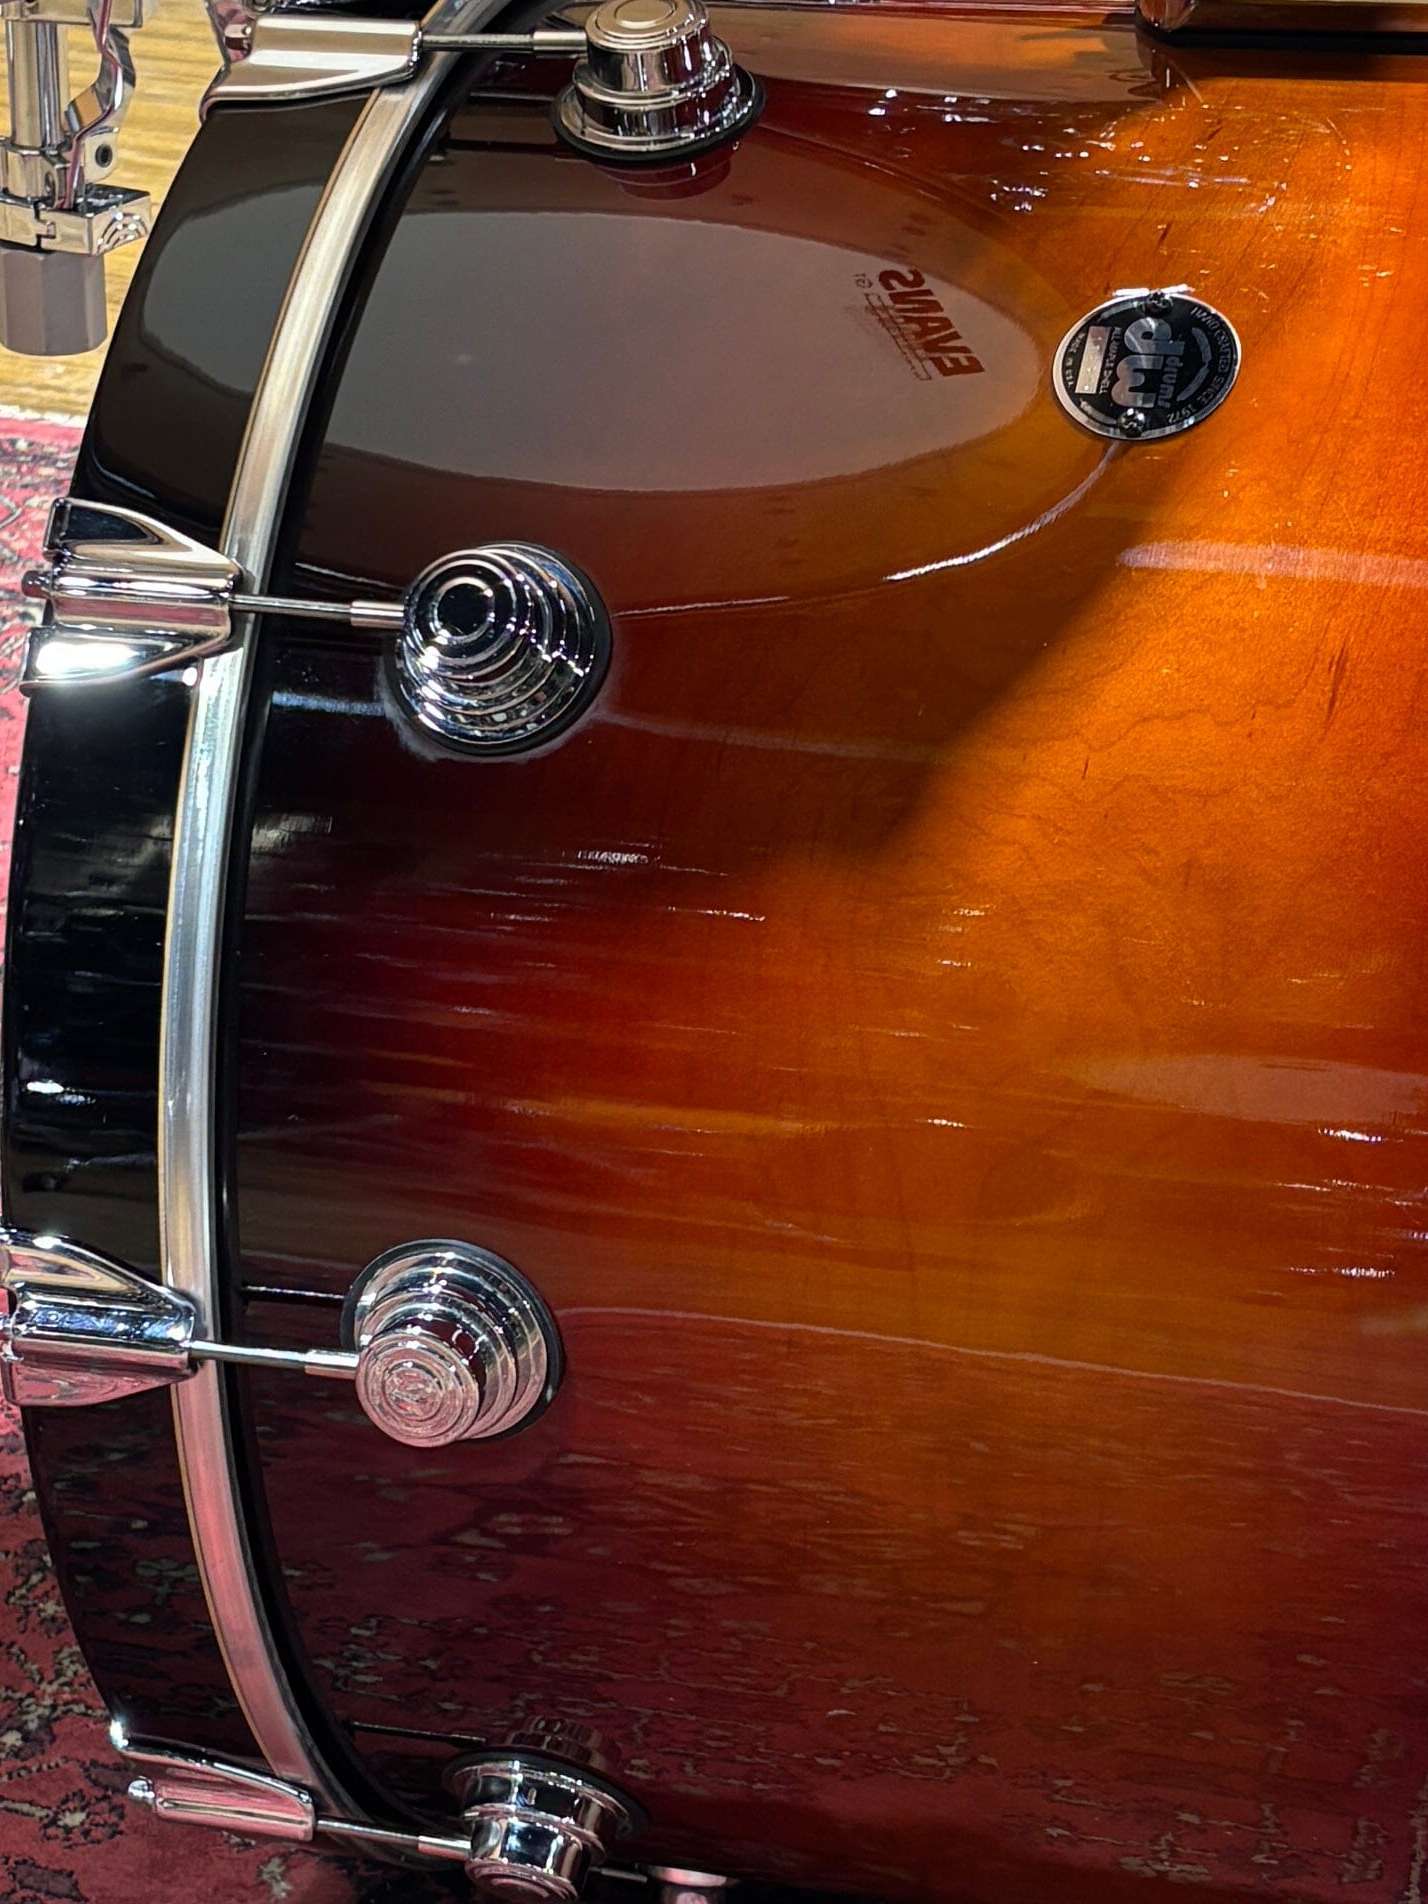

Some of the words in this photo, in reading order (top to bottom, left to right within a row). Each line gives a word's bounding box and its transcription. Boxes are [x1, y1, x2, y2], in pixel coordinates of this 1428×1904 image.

[1112, 317, 1185, 408] dw
[1157, 356, 1183, 408] drums
[1197, 375, 1225, 401] SINCE
